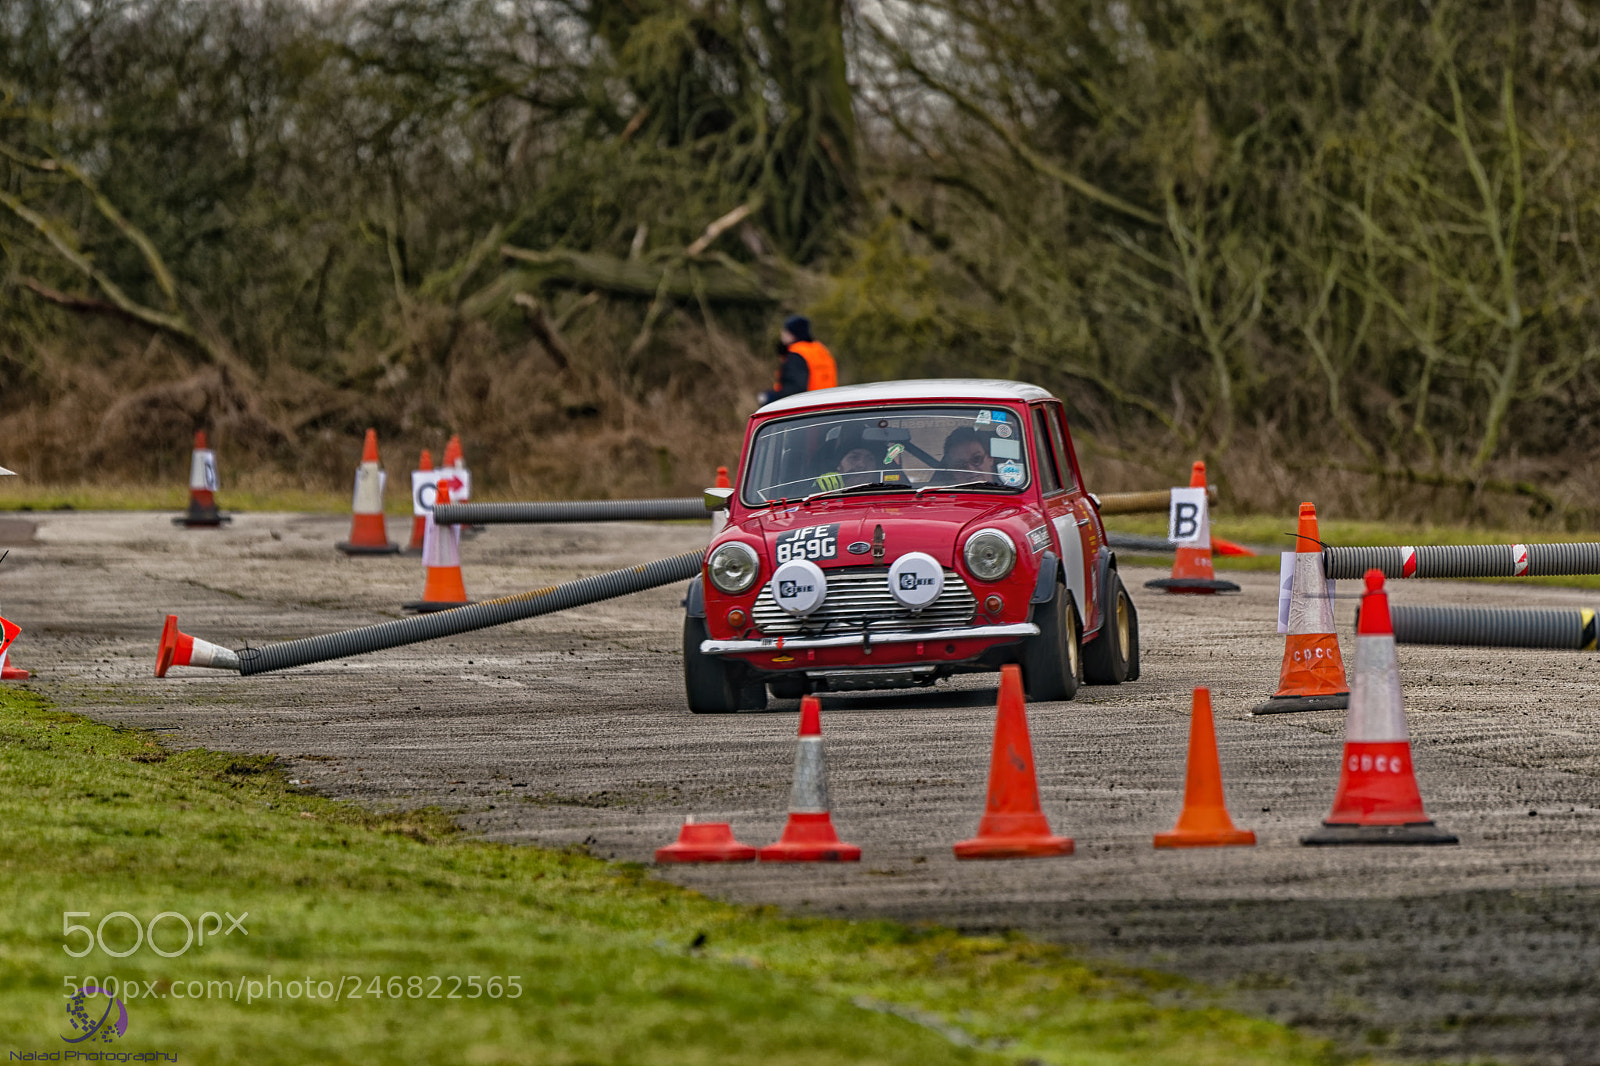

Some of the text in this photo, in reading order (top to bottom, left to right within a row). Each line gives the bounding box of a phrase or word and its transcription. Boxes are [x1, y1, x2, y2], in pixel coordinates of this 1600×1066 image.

[1174, 503, 1198, 538] B
[785, 524, 831, 542] JFE
[776, 537, 836, 564] 859G
[1293, 647, 1333, 662] CDCC
[1348, 754, 1401, 774] CDCC
